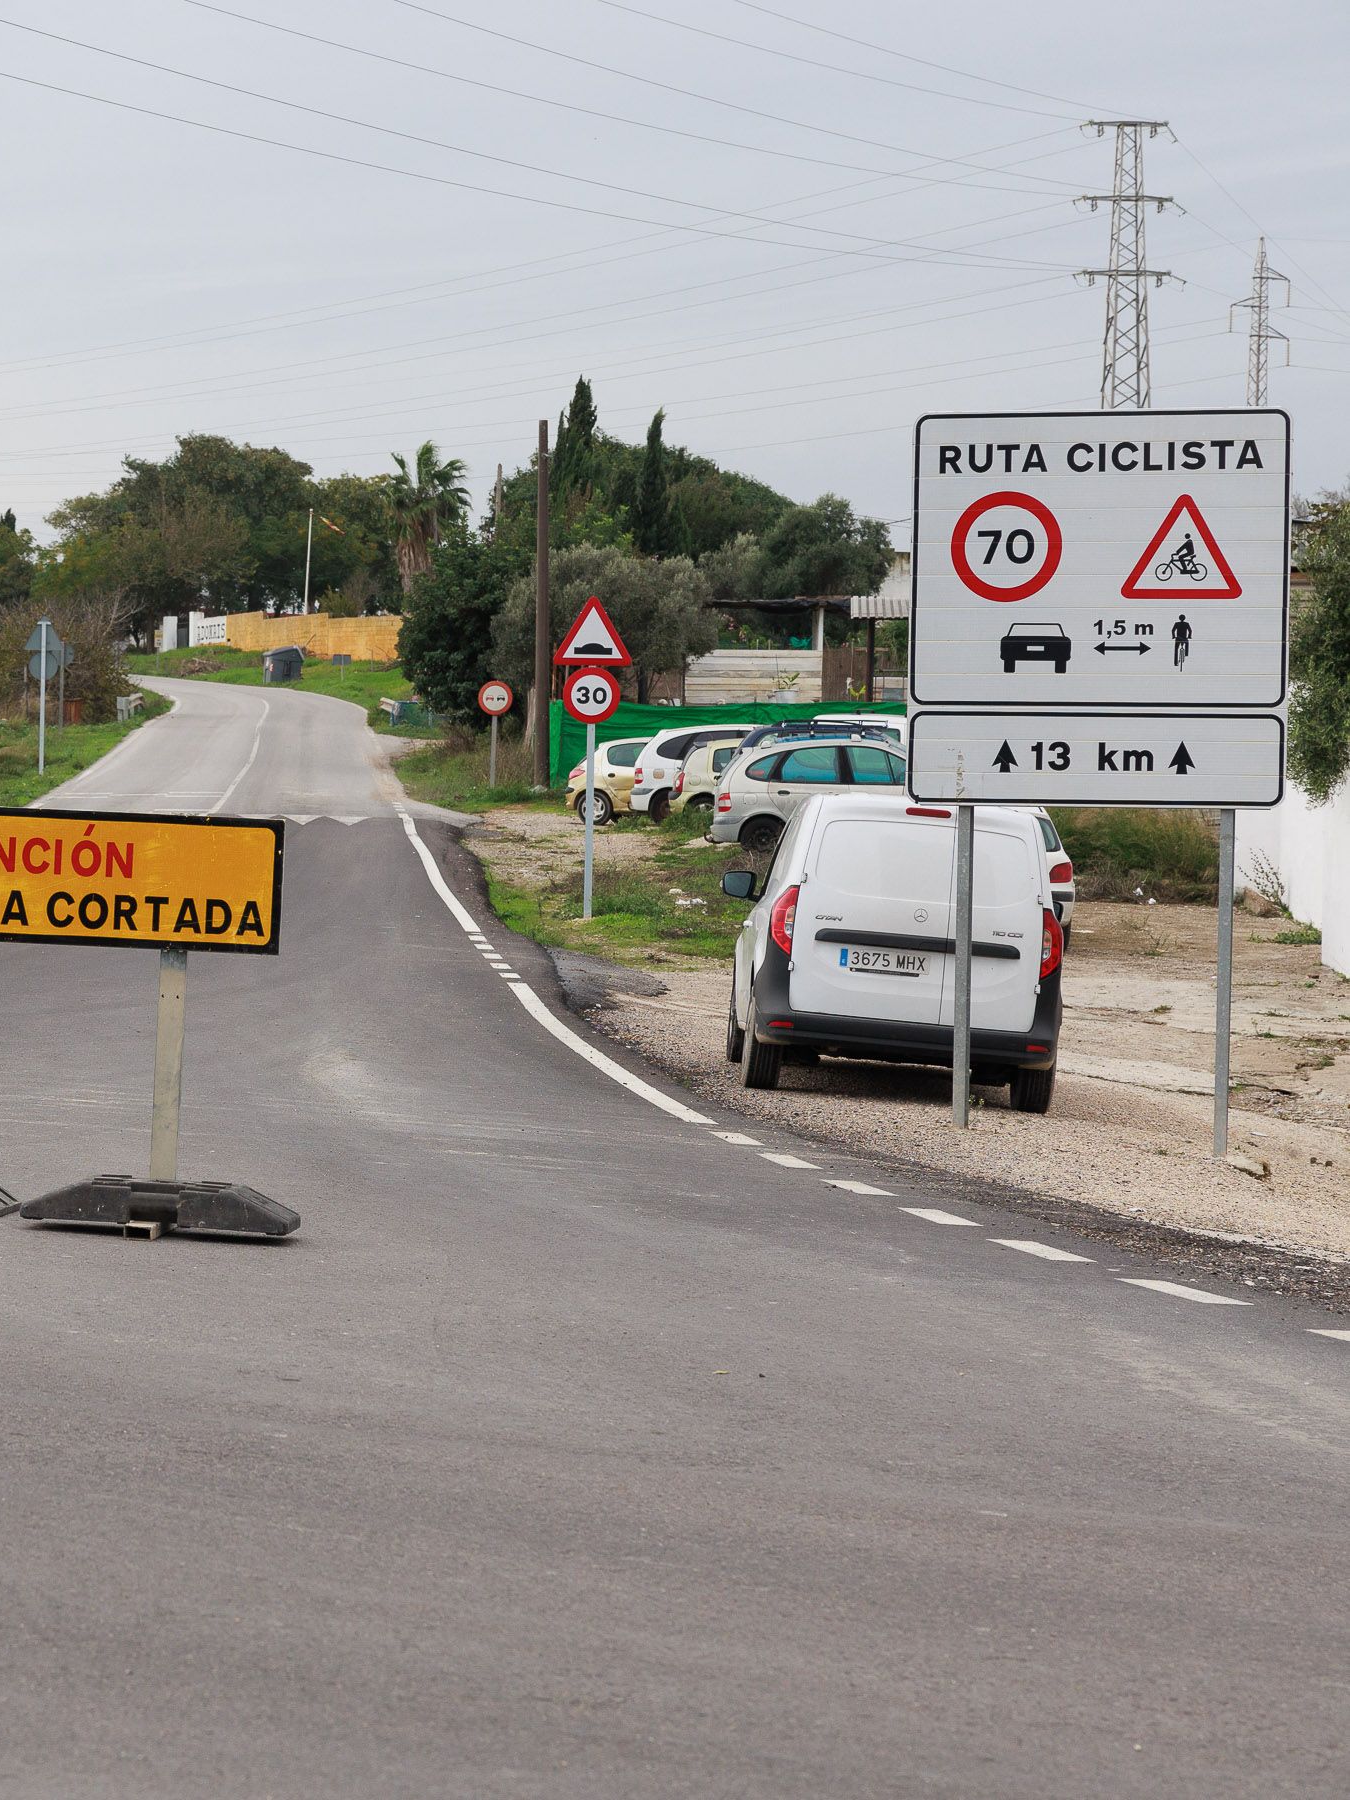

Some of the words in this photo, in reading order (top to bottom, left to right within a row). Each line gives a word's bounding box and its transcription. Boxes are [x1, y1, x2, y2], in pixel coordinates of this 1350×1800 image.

[939, 443, 1048, 473] RUTA
[1066, 440, 1264, 473] CICLISTA
[978, 528, 1035, 565] 70
[1093, 619, 1126, 639] 1,5
[1134, 623, 1154, 636] m
[576, 686, 607, 705] 30
[1031, 741, 1071, 771] 13
[1097, 742, 1154, 772] km
[45, 890, 266, 938] CORTADA
[851, 951, 891, 968] 3675
[896, 954, 926, 972] MHX
